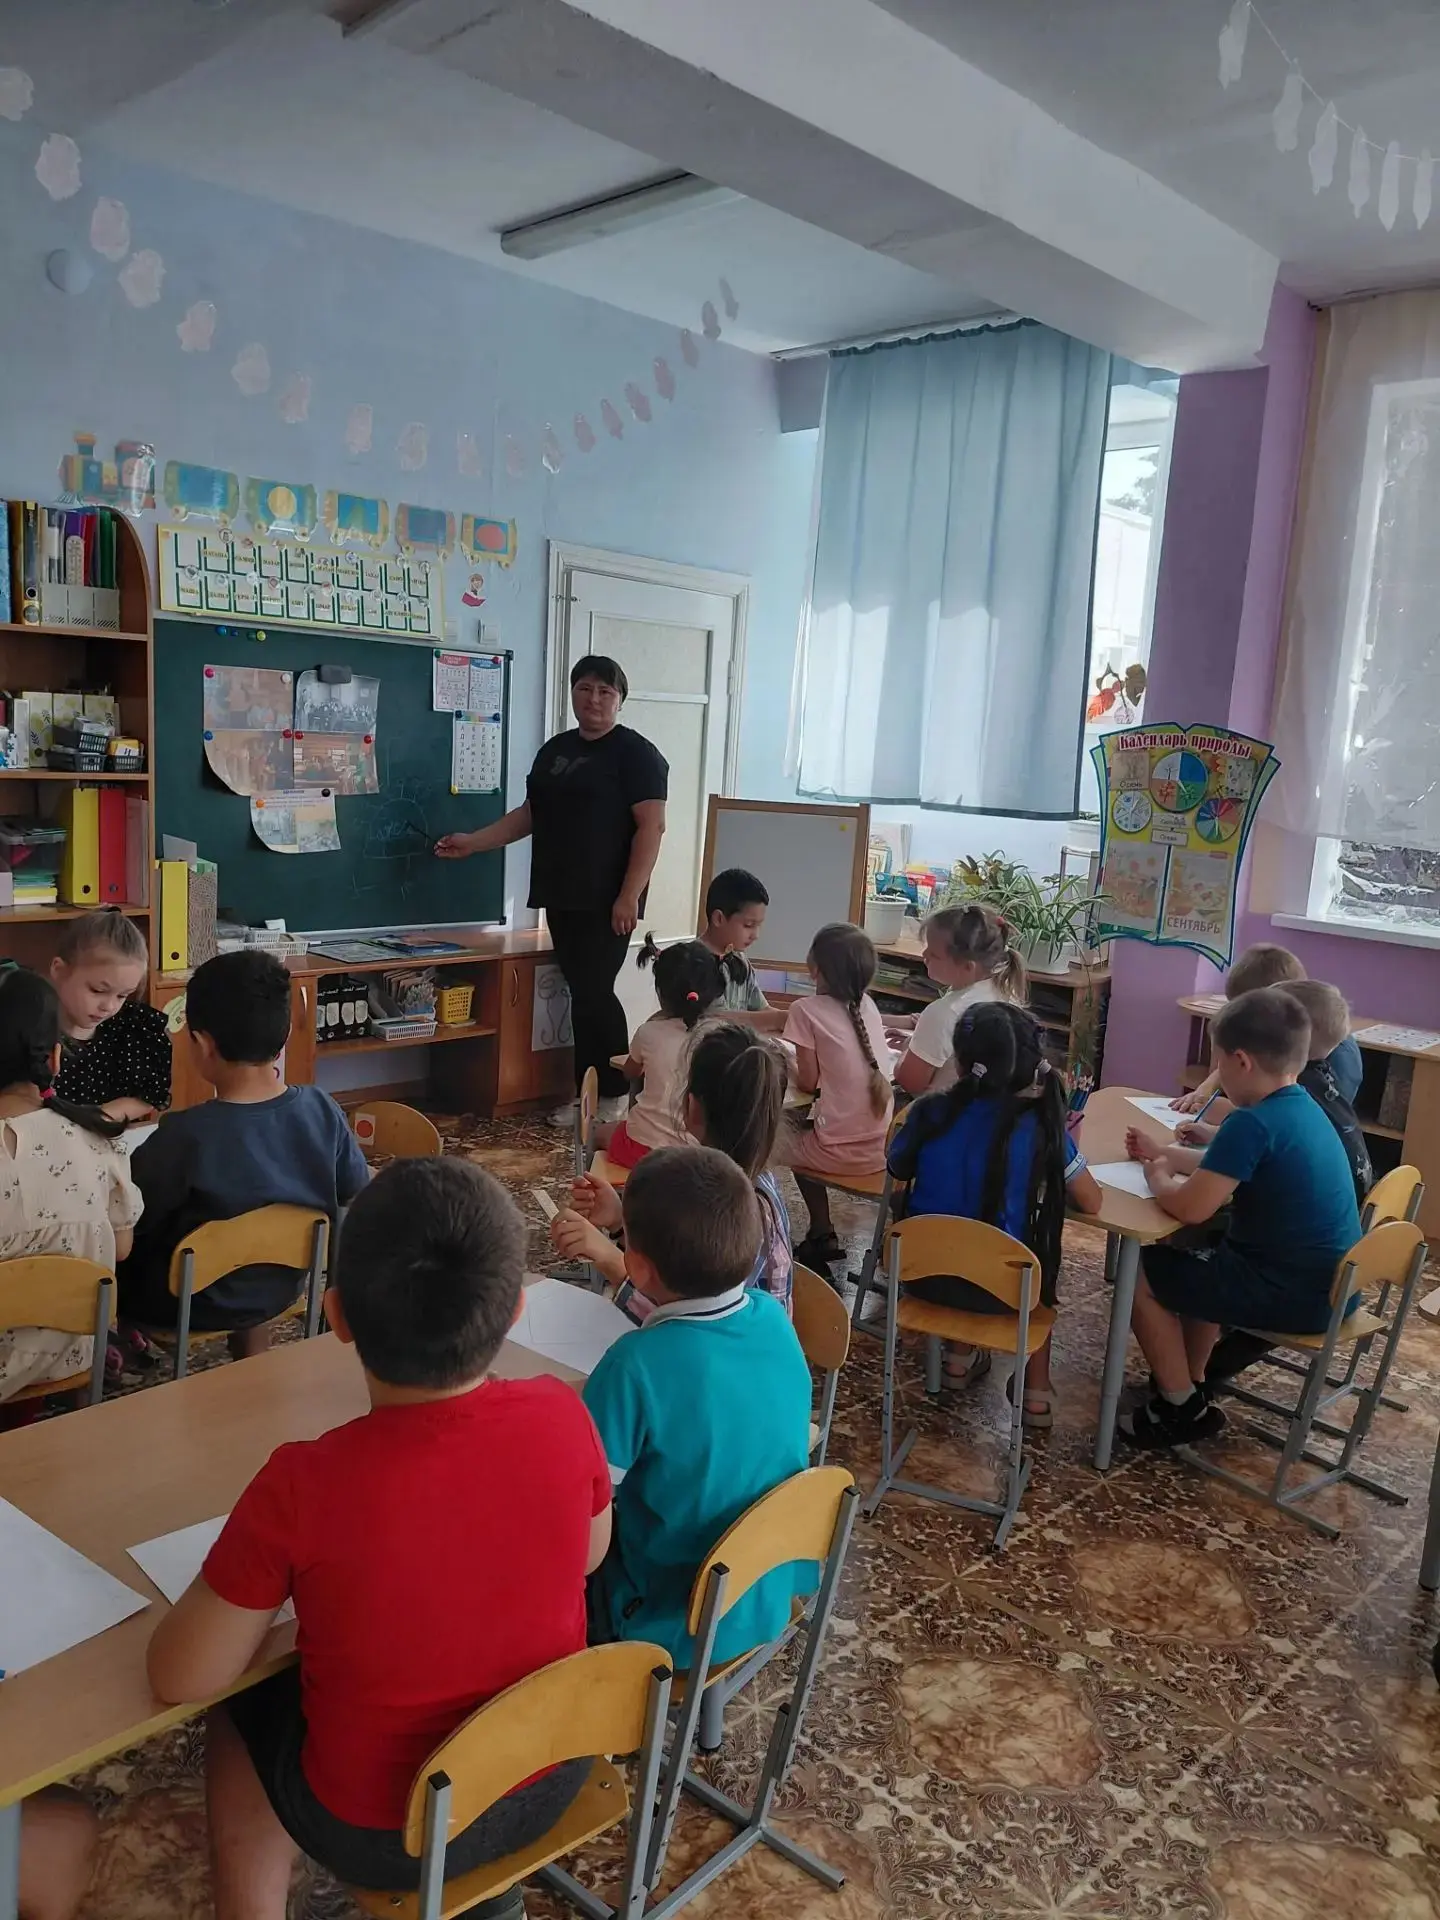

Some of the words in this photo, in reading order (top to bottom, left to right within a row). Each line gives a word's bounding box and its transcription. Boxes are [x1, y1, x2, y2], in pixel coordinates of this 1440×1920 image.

[1120, 734, 1187, 749] Календарь
[1191, 735, 1251, 757] природы
[1167, 916, 1220, 934] СЕНТЯБРЬ
